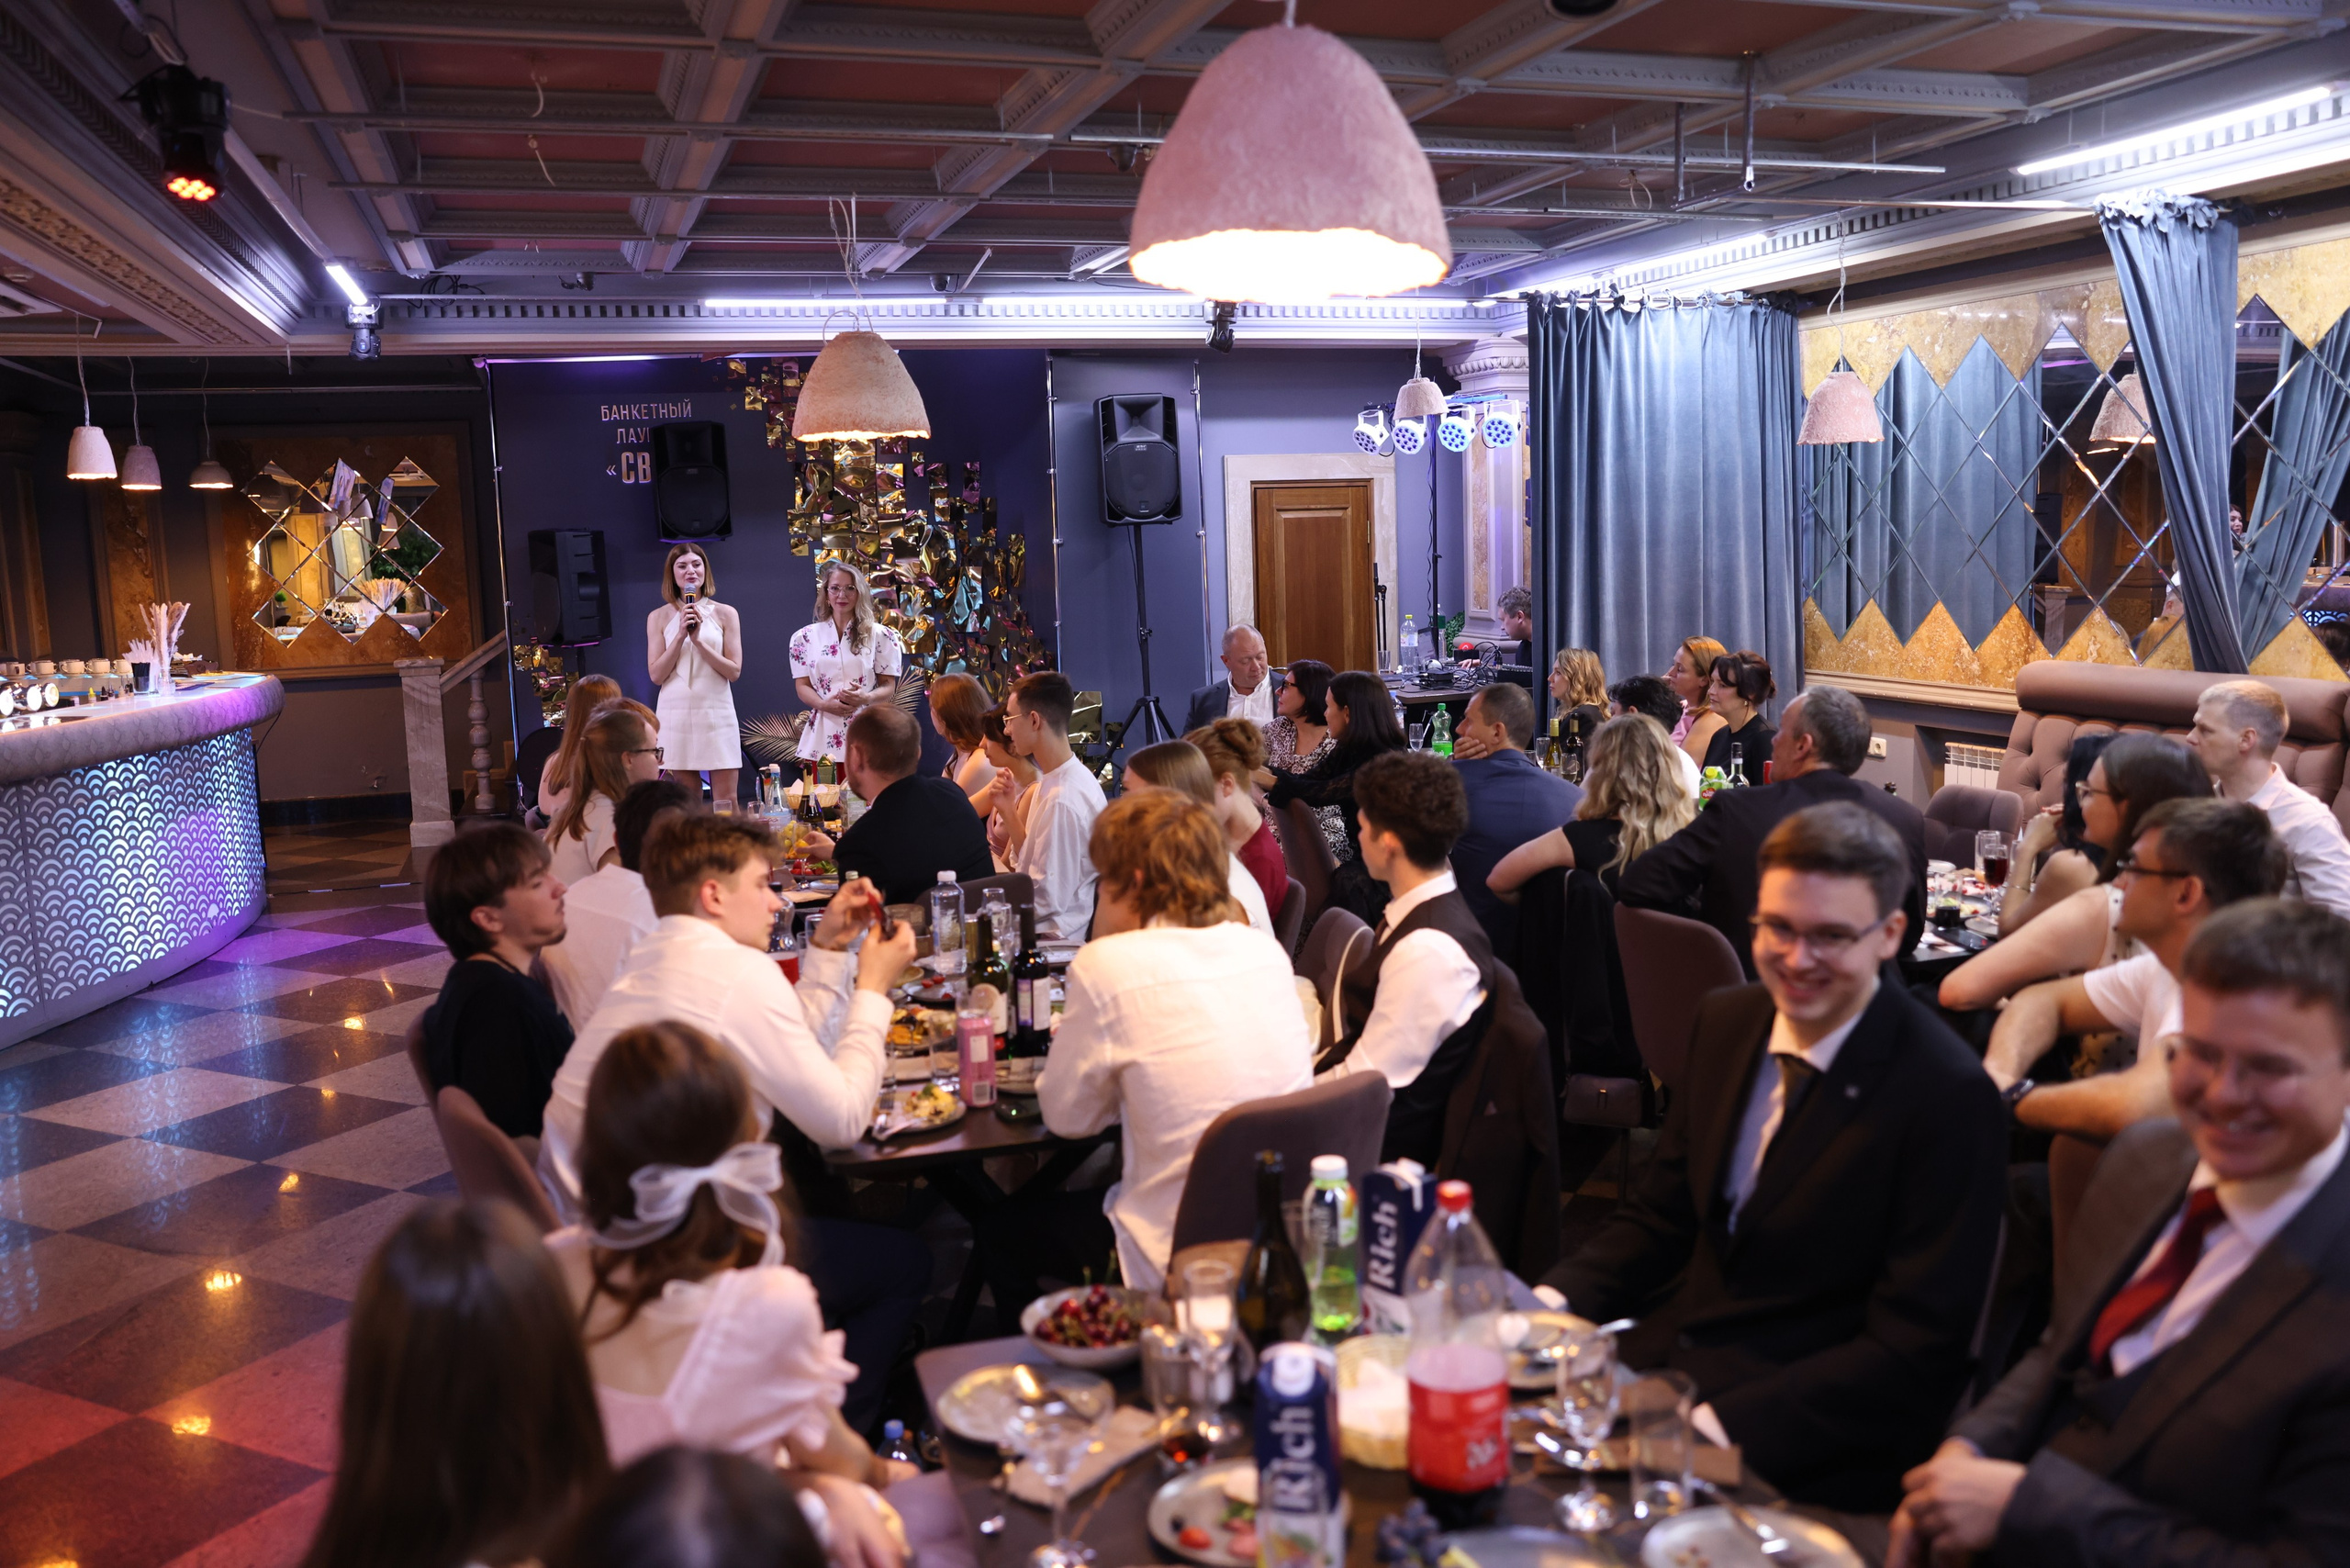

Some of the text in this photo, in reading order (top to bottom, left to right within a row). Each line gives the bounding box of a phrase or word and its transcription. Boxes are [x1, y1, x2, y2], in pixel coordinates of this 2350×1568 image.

[600, 398, 692, 421] БАНКЕТНЫЙ
[616, 427, 651, 444] ЛАУ
[1368, 1201, 1399, 1290] Rich
[1268, 1406, 1317, 1510] Rich
